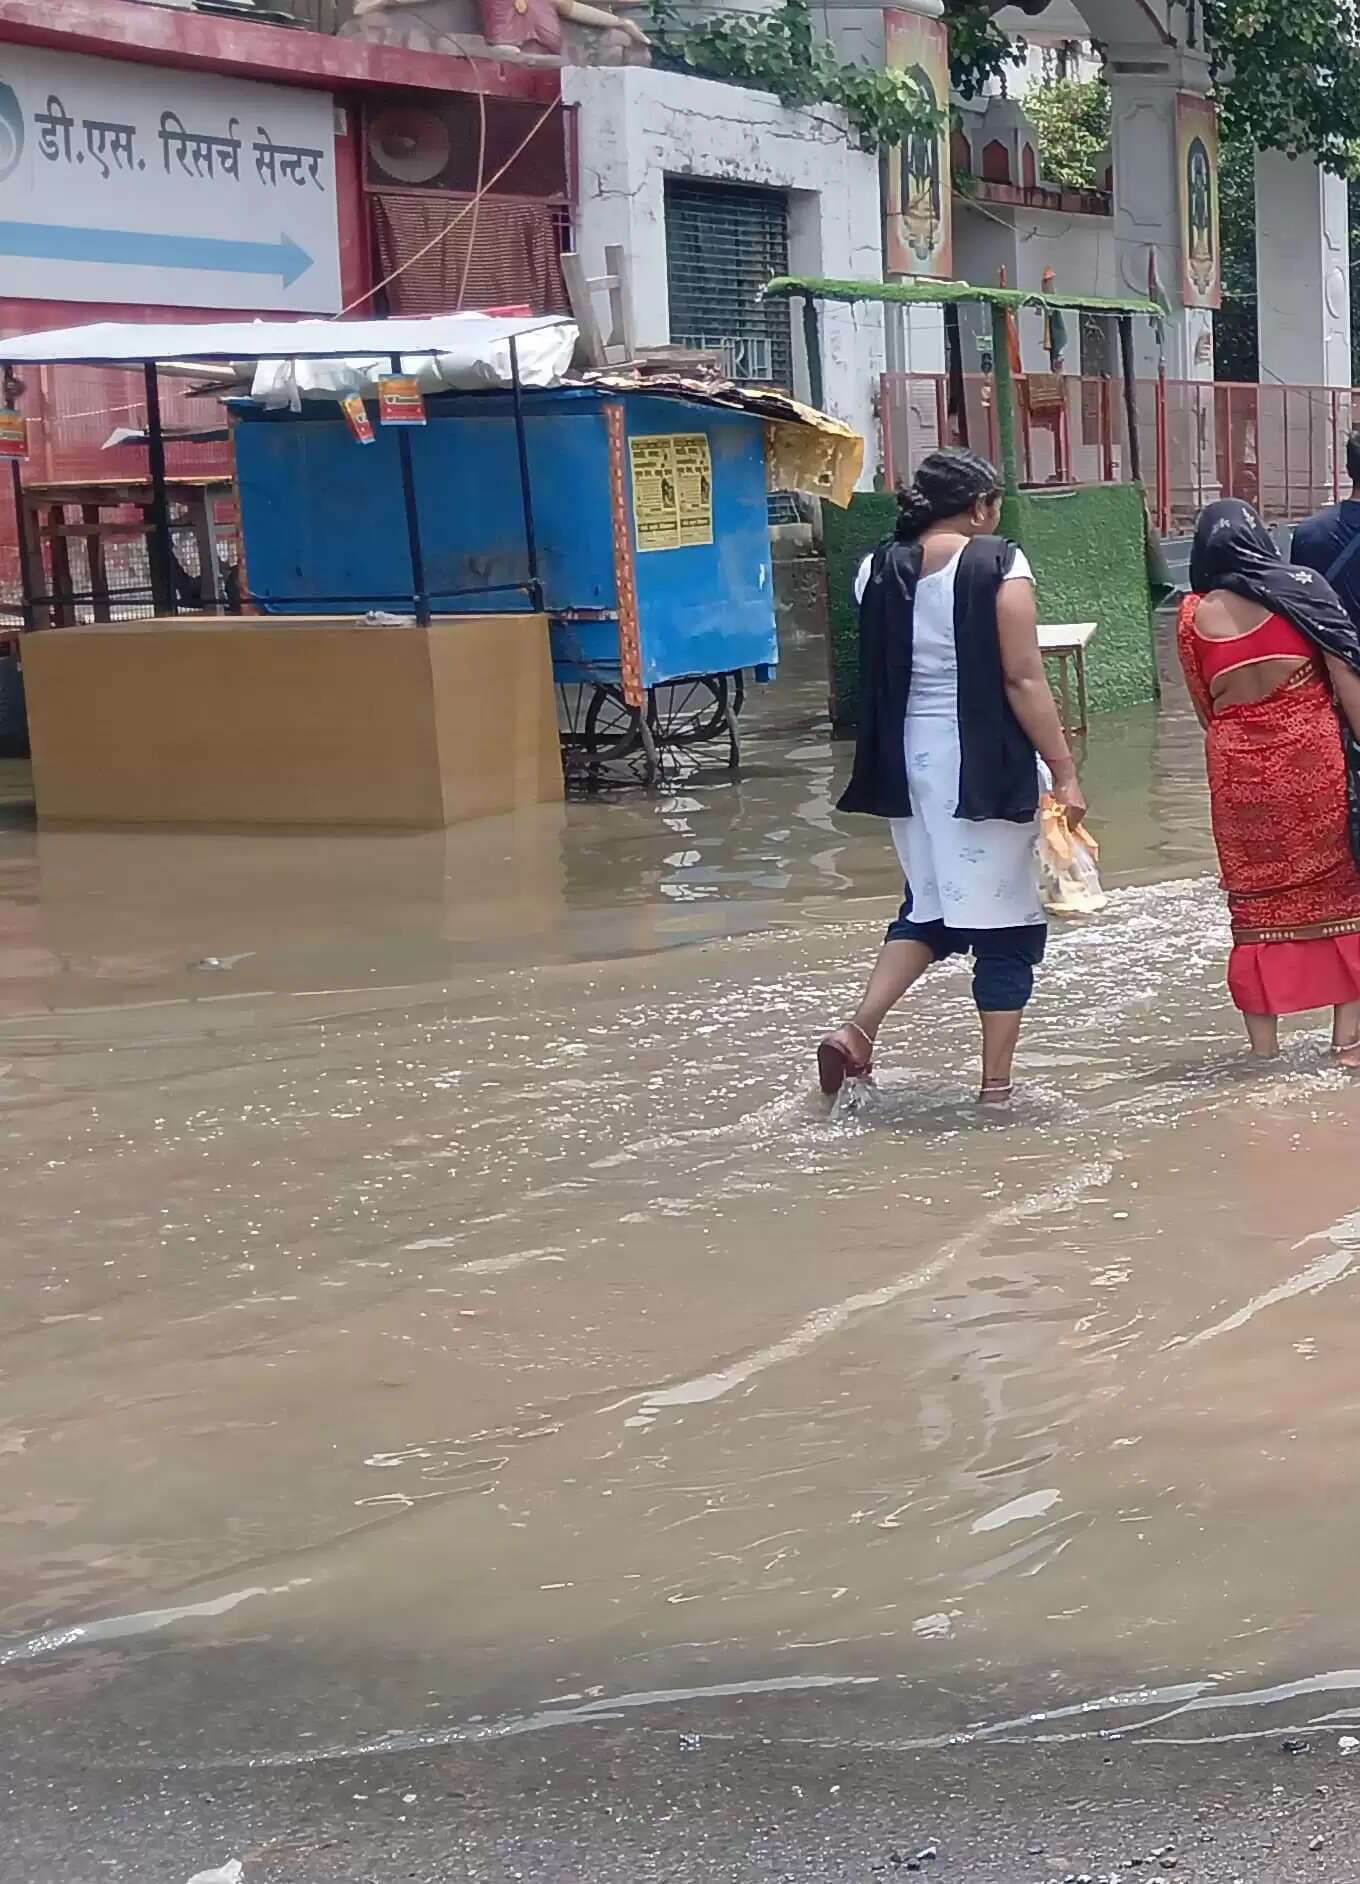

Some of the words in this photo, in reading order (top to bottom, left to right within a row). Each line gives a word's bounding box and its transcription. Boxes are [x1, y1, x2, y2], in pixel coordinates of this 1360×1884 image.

[34, 94, 146, 179] डी.एस.
[158, 111, 241, 182] रिसर्च
[253, 126, 325, 191] सेन्टर
